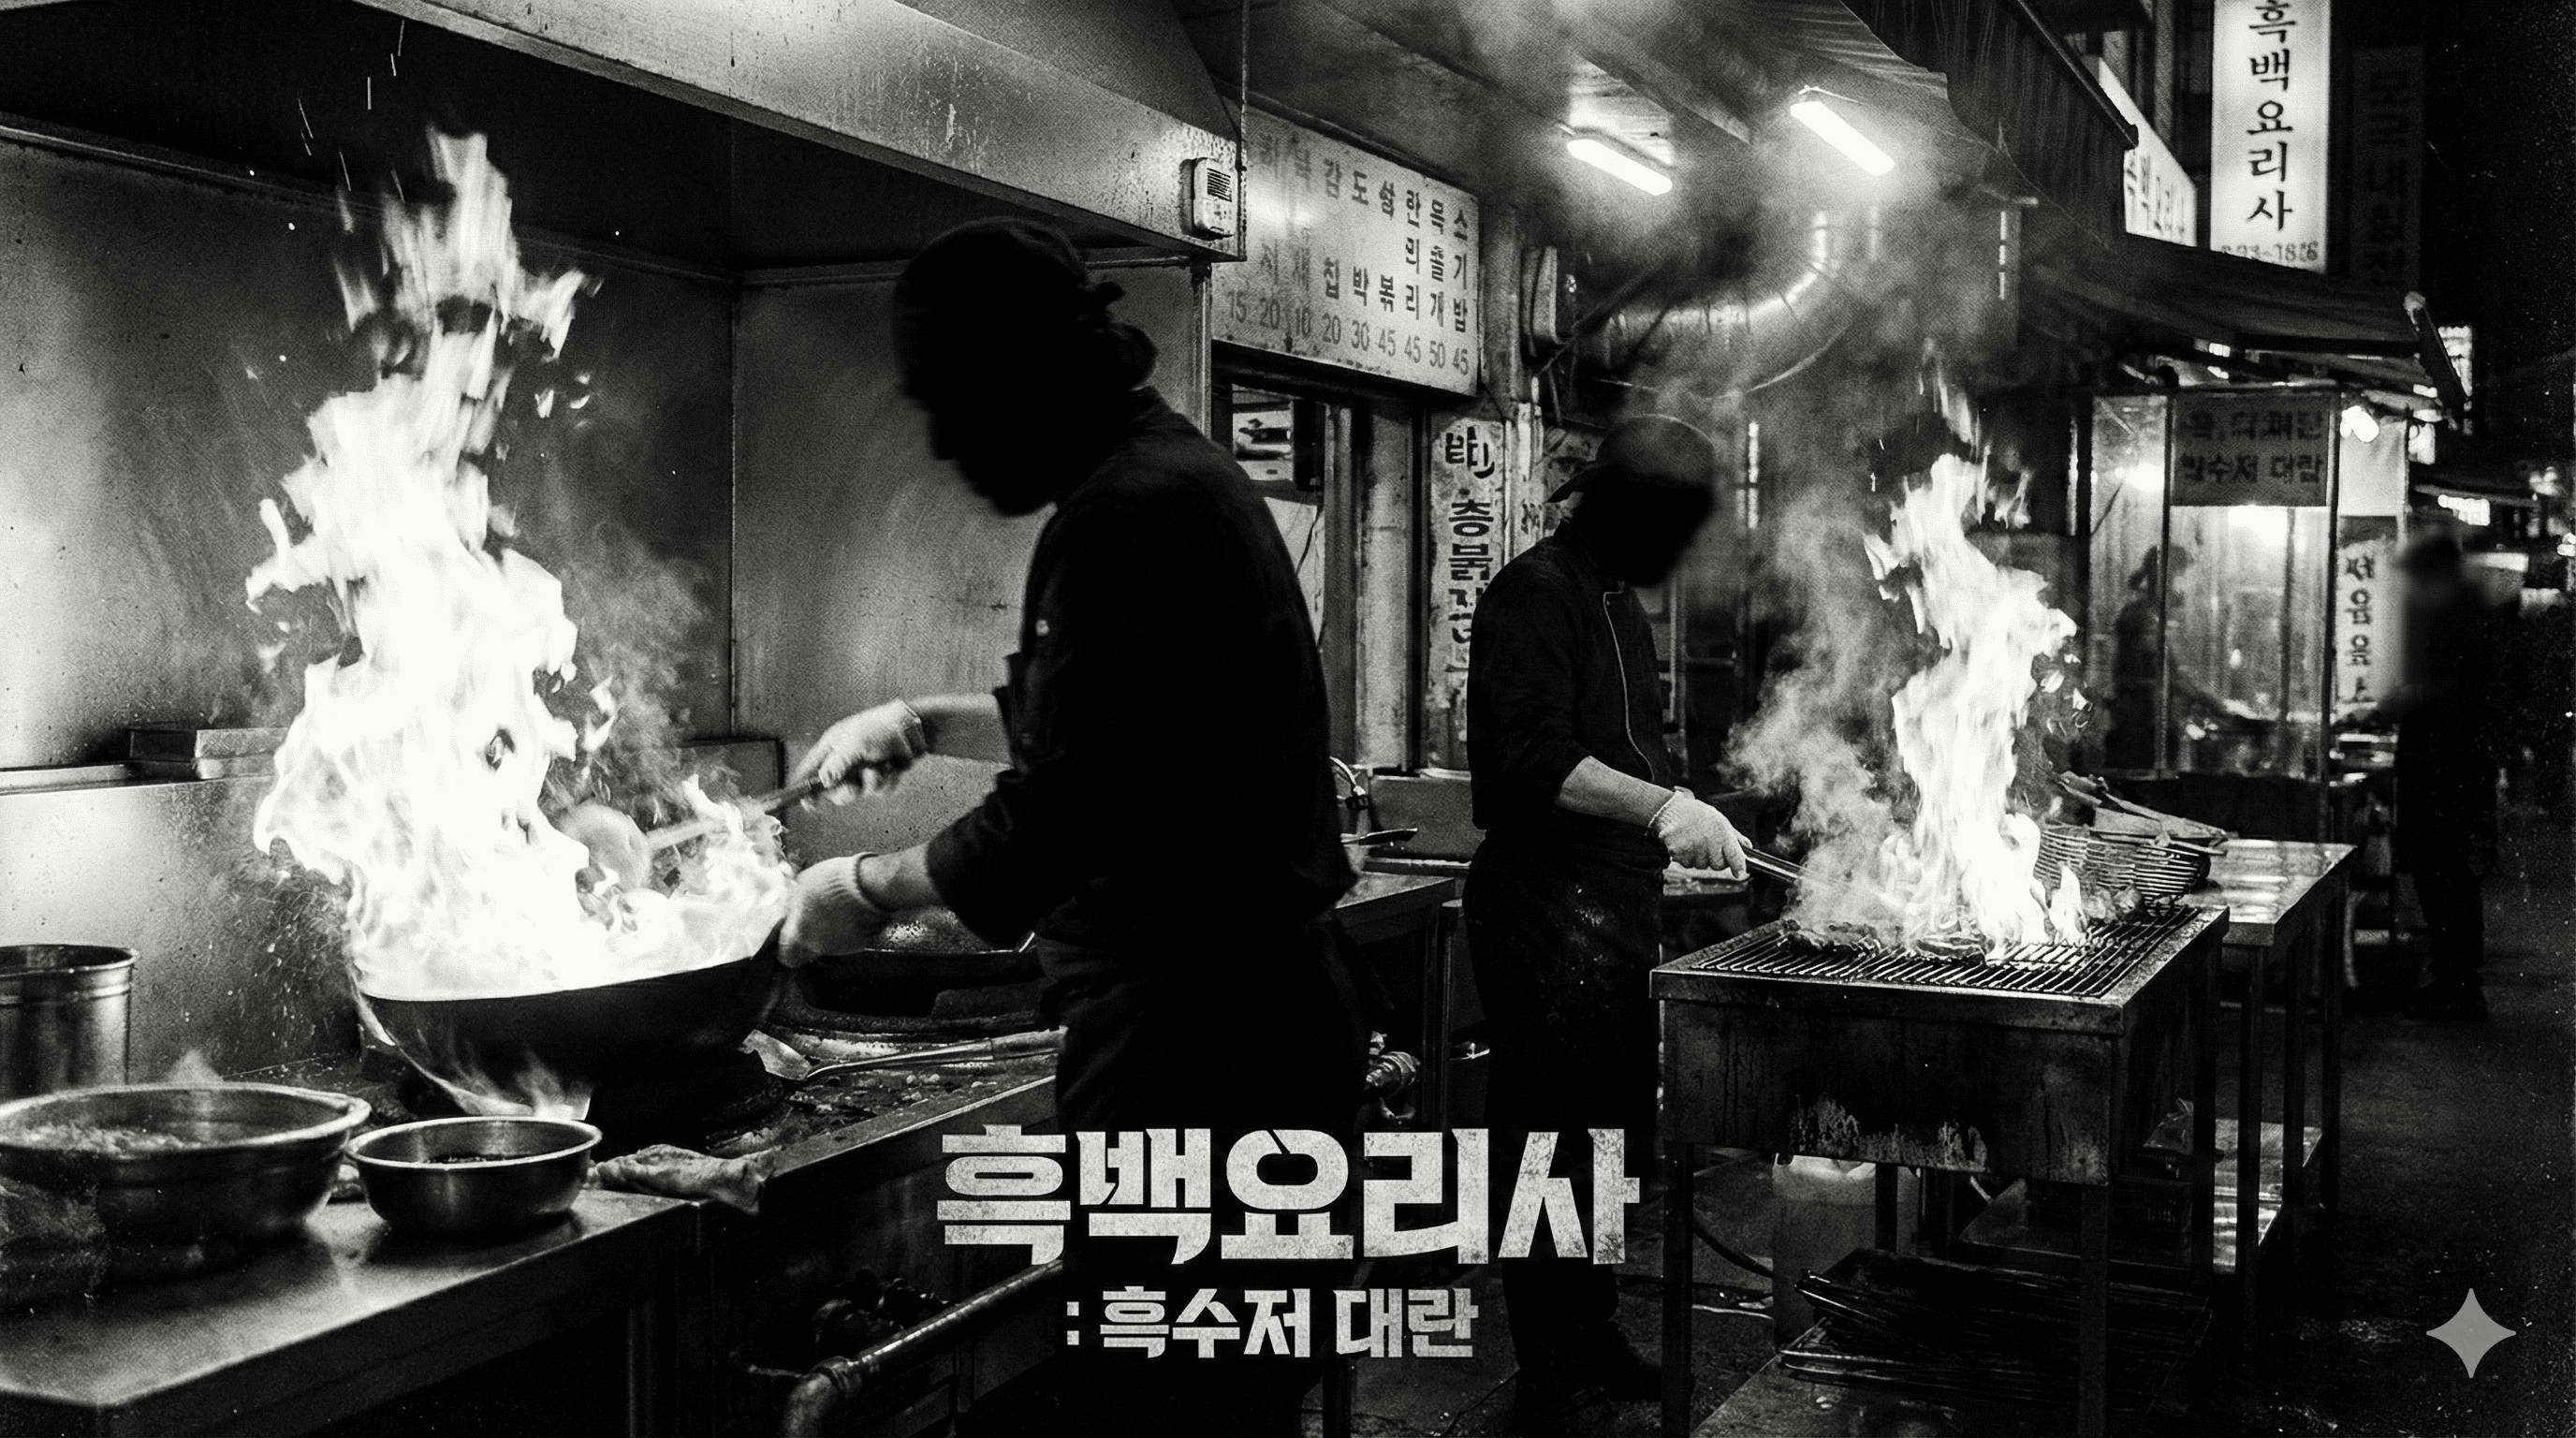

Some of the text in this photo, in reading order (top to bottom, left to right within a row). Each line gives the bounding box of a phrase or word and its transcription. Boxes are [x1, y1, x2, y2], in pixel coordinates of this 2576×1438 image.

[2247, 0, 2296, 231] 흑백요리사
[1322, 312, 1341, 345] 20
[1351, 319, 1369, 351] 30
[1378, 330, 1396, 357] 45
[1404, 334, 1421, 363] 45
[1429, 340, 1445, 368] 50
[1453, 347, 1469, 375] 45
